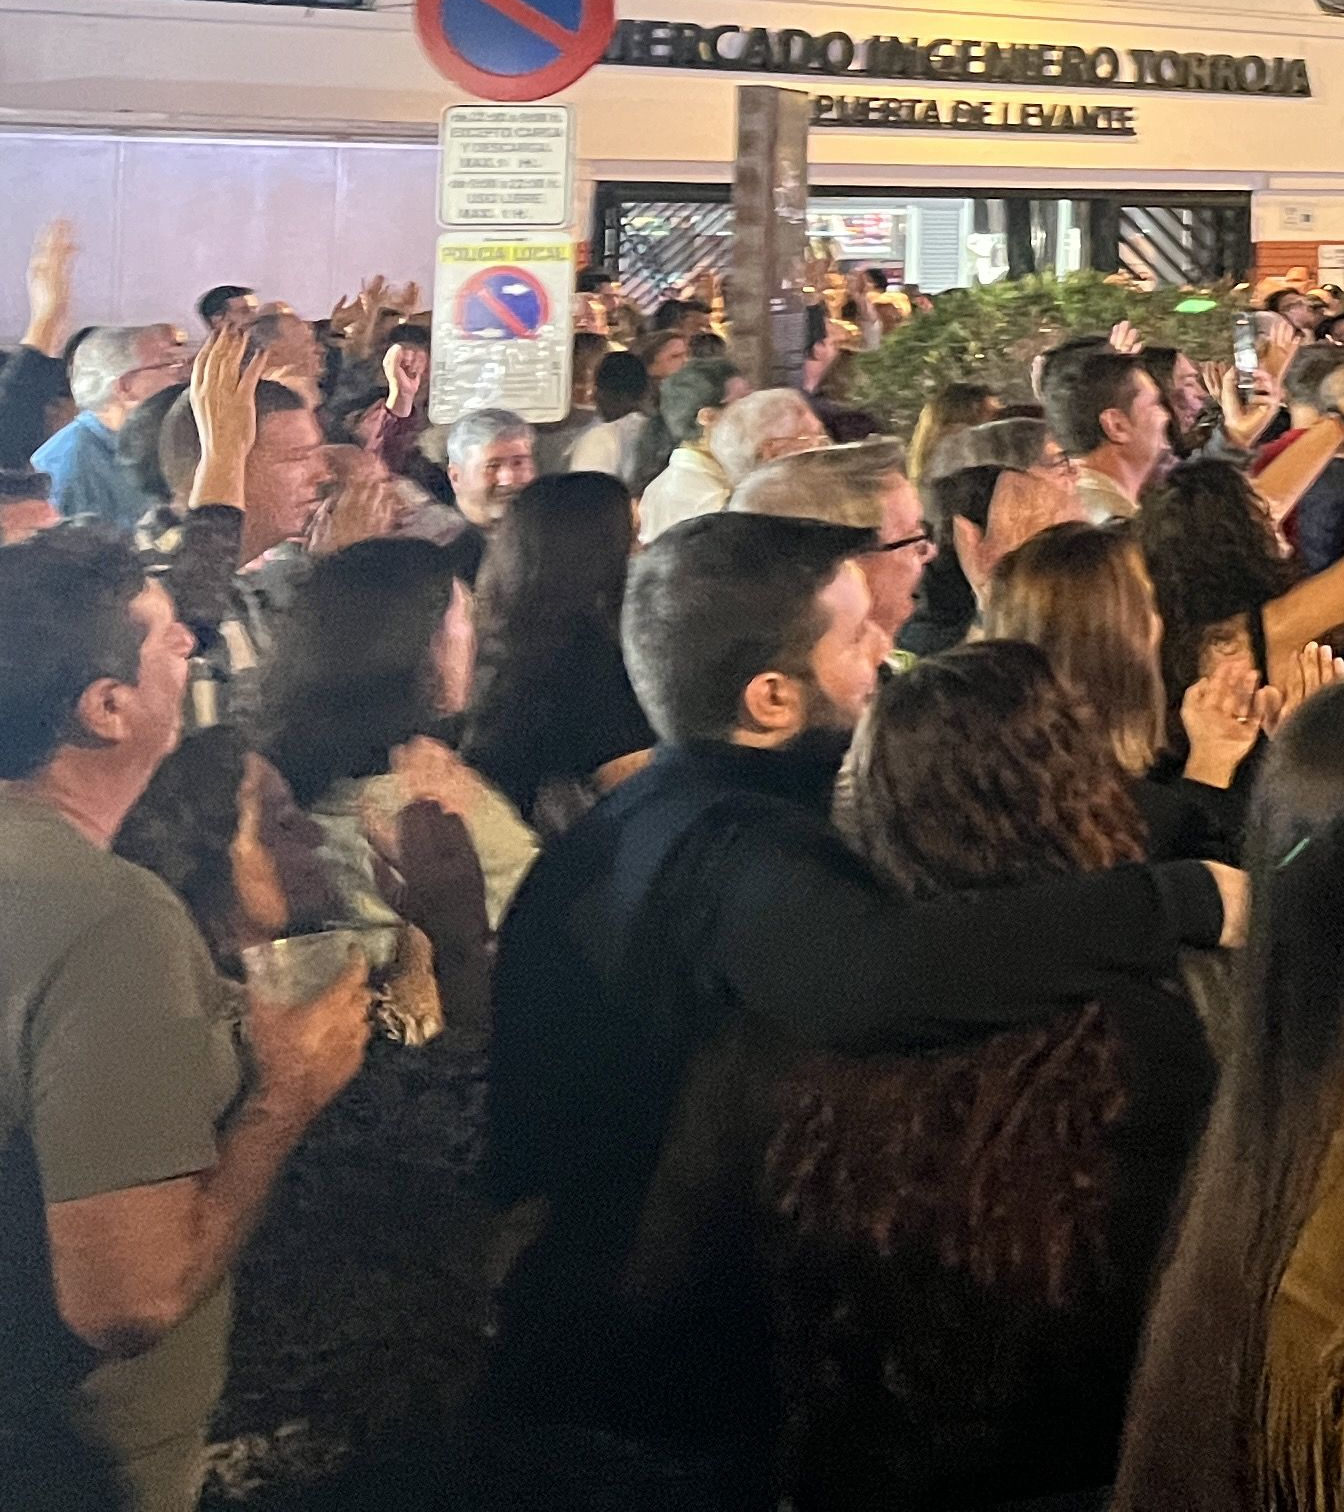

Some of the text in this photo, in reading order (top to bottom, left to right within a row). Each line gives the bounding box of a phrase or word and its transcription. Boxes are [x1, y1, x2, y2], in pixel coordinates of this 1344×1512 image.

[864, 35, 1119, 82] INGENIERO
[1126, 49, 1311, 95] TORROJA
[813, 94, 1137, 134] PUERTA DE LEVANTE
[512, 246, 570, 262] LOCAL
